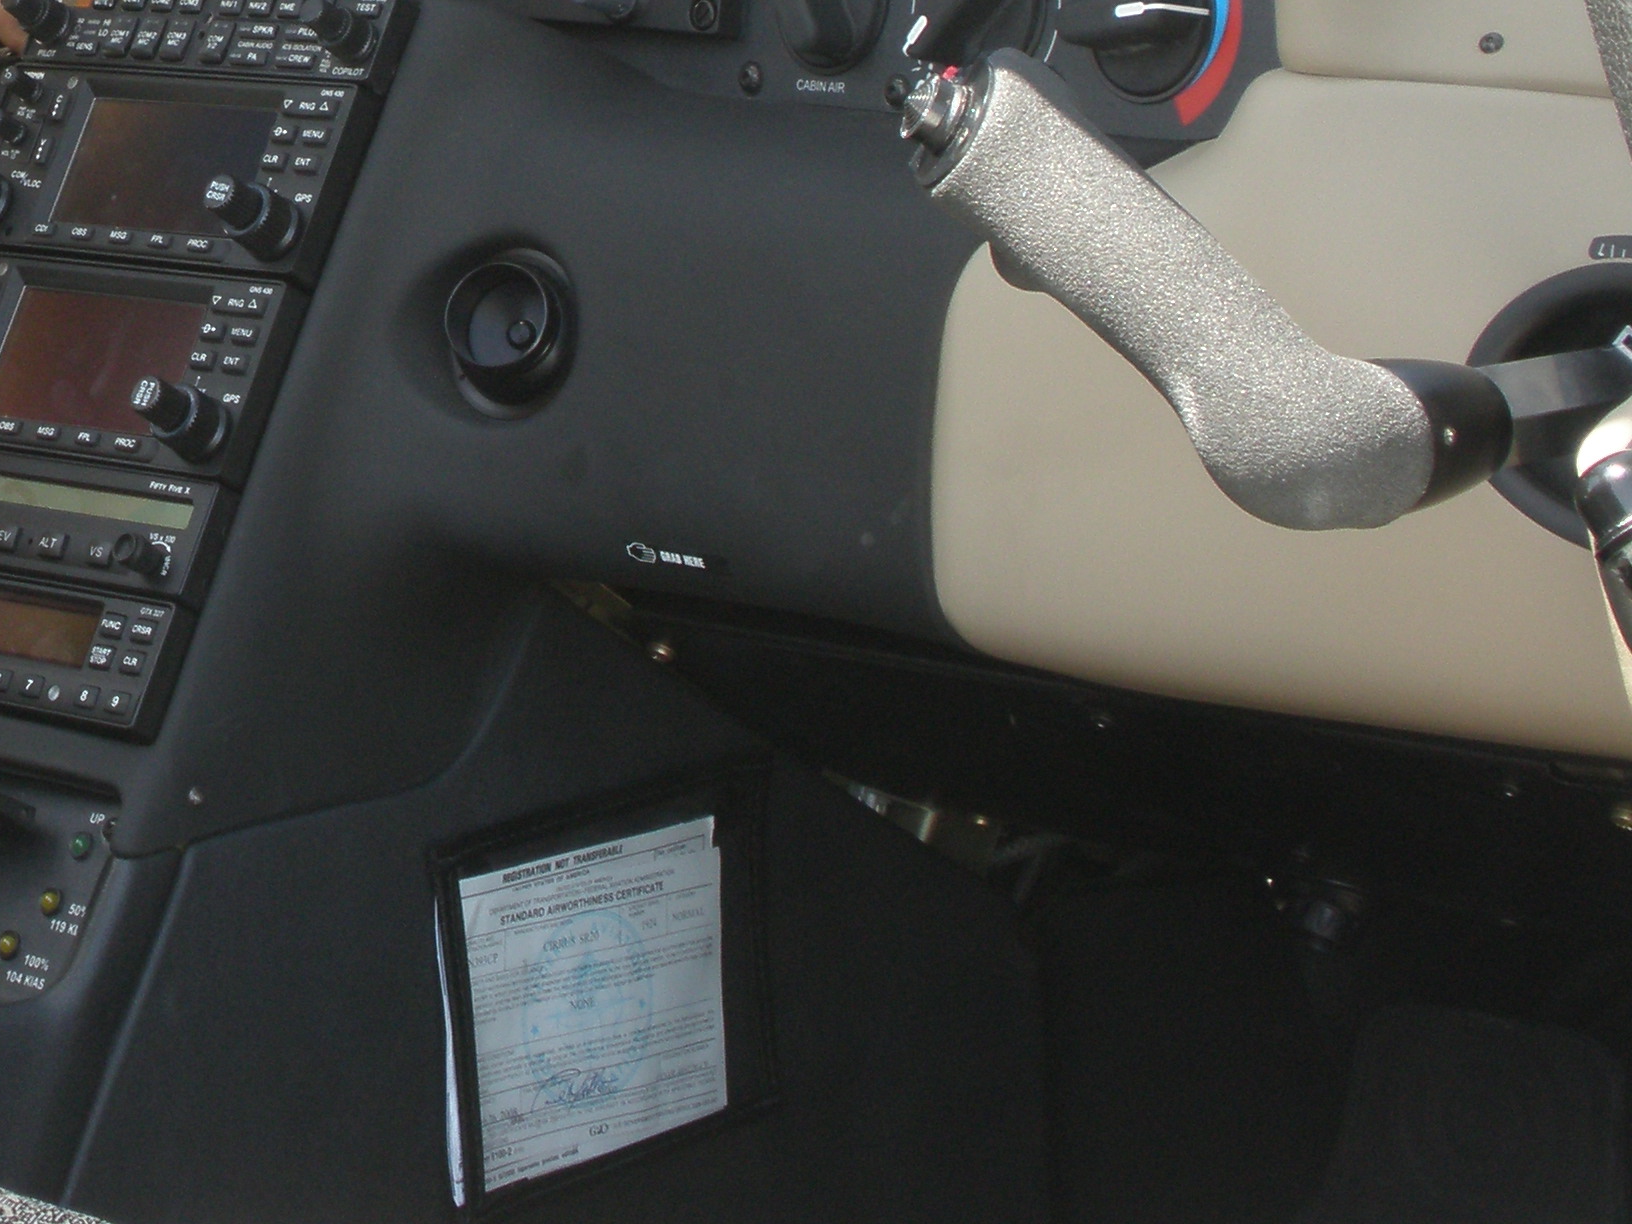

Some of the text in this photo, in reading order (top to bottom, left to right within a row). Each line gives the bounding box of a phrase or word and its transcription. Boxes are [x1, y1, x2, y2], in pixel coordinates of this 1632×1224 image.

[220, 0, 238, 9] NAV1
[248, 0, 268, 11] NAV2
[279, 1, 296, 12] DME
[356, 2, 377, 13] TEST
[110, 28, 130, 39] COM1
[137, 30, 158, 40] COM2
[166, 30, 187, 41] COM3
[252, 25, 274, 36] SPKR
[37, 48, 57, 58] PILOT
[288, 54, 311, 64] CREW
[332, 66, 364, 77] COPILOT
[796, 78, 846, 94] CABIN AIR
[298, 101, 316, 111] RNG
[302, 129, 325, 139] MENU
[262, 154, 279, 164] CLR
[294, 156, 311, 167] ENT
[210, 180, 230, 193] PUSH
[206, 189, 226, 202] CRSR
[294, 192, 313, 204] GPS
[34, 223, 49, 233] CDI
[71, 226, 87, 237] OBS
[109, 230, 127, 240] MSG
[150, 234, 164, 244] FPL
[187, 238, 209, 249] PROC
[227, 298, 244, 308] RNG
[231, 328, 253, 338] MENU
[191, 352, 207, 362] CLR
[223, 356, 240, 366] ENT
[133, 380, 148, 406] CRSR
[140, 382, 155, 406] PUSH
[223, 393, 241, 404] GPS
[36, 426, 55, 437] MSG
[78, 431, 91, 442] FPL
[114, 437, 136, 448] PROC
[38, 536, 58, 549] ALT
[89, 546, 104, 558] VS
[100, 618, 121, 631] FUNC
[131, 624, 152, 636] CRSR
[122, 656, 138, 668] CLR
[25, 678, 34, 690] 7
[80, 690, 89, 702] 8
[110, 695, 120, 708] 9
[89, 812, 106, 825] UP
[502, 862, 552, 883] REGISTRATION
[555, 856, 570, 871] NOT
[500, 907, 545, 926] STANDARD
[547, 892, 614, 916] AIRWORTHINESS
[615, 881, 665, 901] CERTIFICATE
[49, 919, 66, 933] 119
[543, 931, 576, 952] CIRRUS
[24, 954, 50, 971] 100%
[6, 970, 46, 990] 104 KIAS
